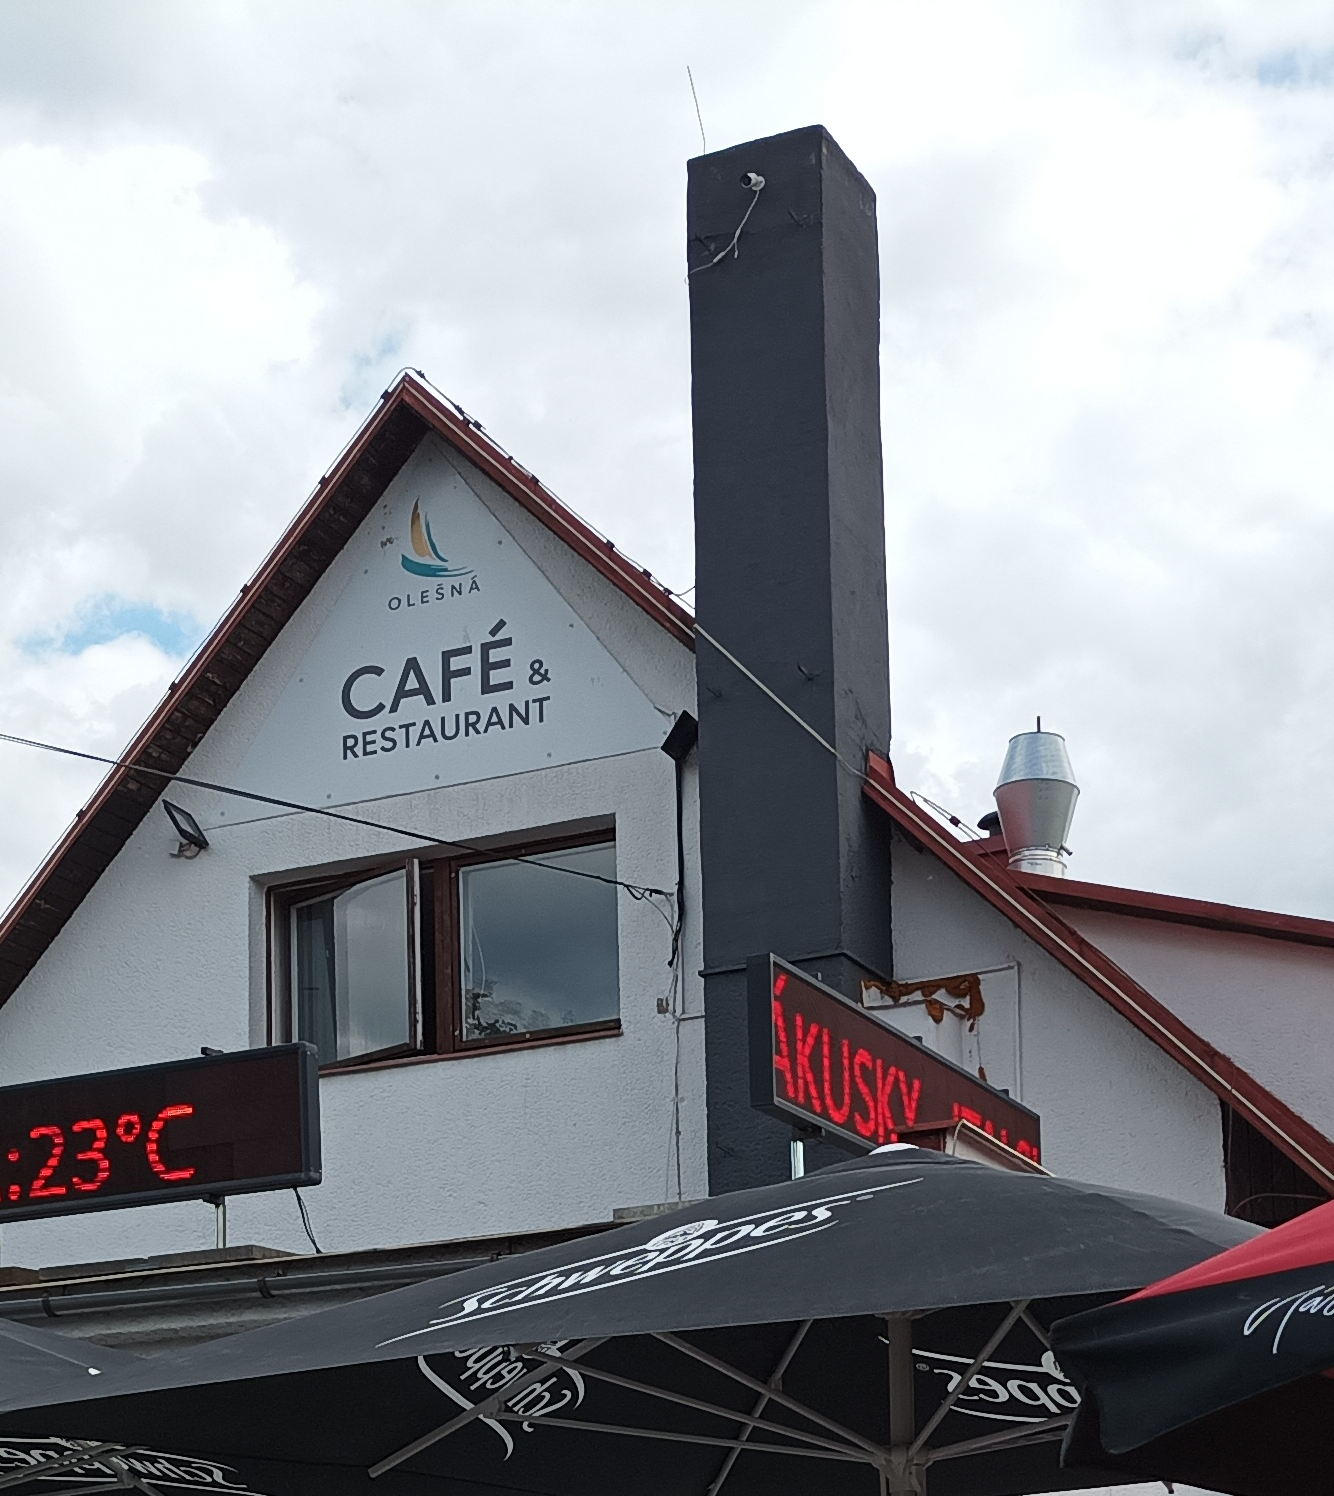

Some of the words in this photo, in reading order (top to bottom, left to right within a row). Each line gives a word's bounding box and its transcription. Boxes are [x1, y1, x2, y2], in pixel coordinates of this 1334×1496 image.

[387, 574, 481, 611] OLEŠNÁ
[341, 618, 514, 720] CAFÉ
[528, 659, 552, 686] &
[342, 696, 552, 761] RESTAURANT
[429, 1200, 851, 1325] Schweppes
